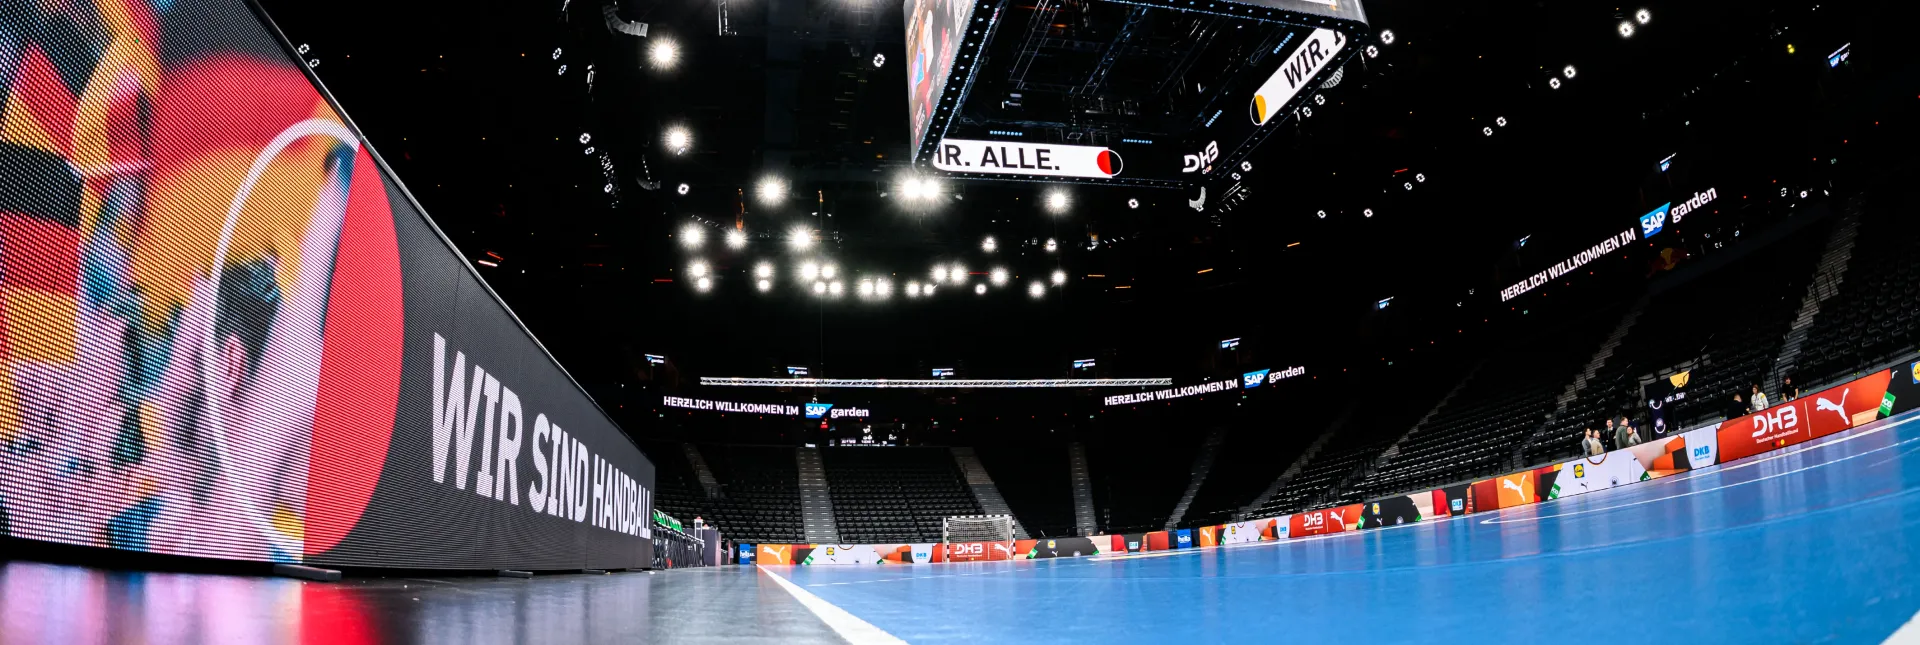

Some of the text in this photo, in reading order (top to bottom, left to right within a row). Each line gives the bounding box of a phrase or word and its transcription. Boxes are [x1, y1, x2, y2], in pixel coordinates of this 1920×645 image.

[1283, 38, 1330, 90] WIR.
[979, 145, 1061, 171] ALLE.
[1182, 140, 1219, 173] DHB
[1500, 187, 1718, 302] HERZLICH WILLKOMMEN IM SAP garden
[1104, 365, 1305, 406] HERZLICH WILLKOMMEN IM SAP garden
[663, 395, 869, 419] HERZLICH WILLKOMMEN IM SAP garden
[1751, 405, 1798, 438] DHB
[432, 332, 651, 540] WIR SIND HANDBALL
[1693, 445, 1710, 458] DKB
[1303, 512, 1323, 527] DHB
[954, 543, 983, 555] DHB
